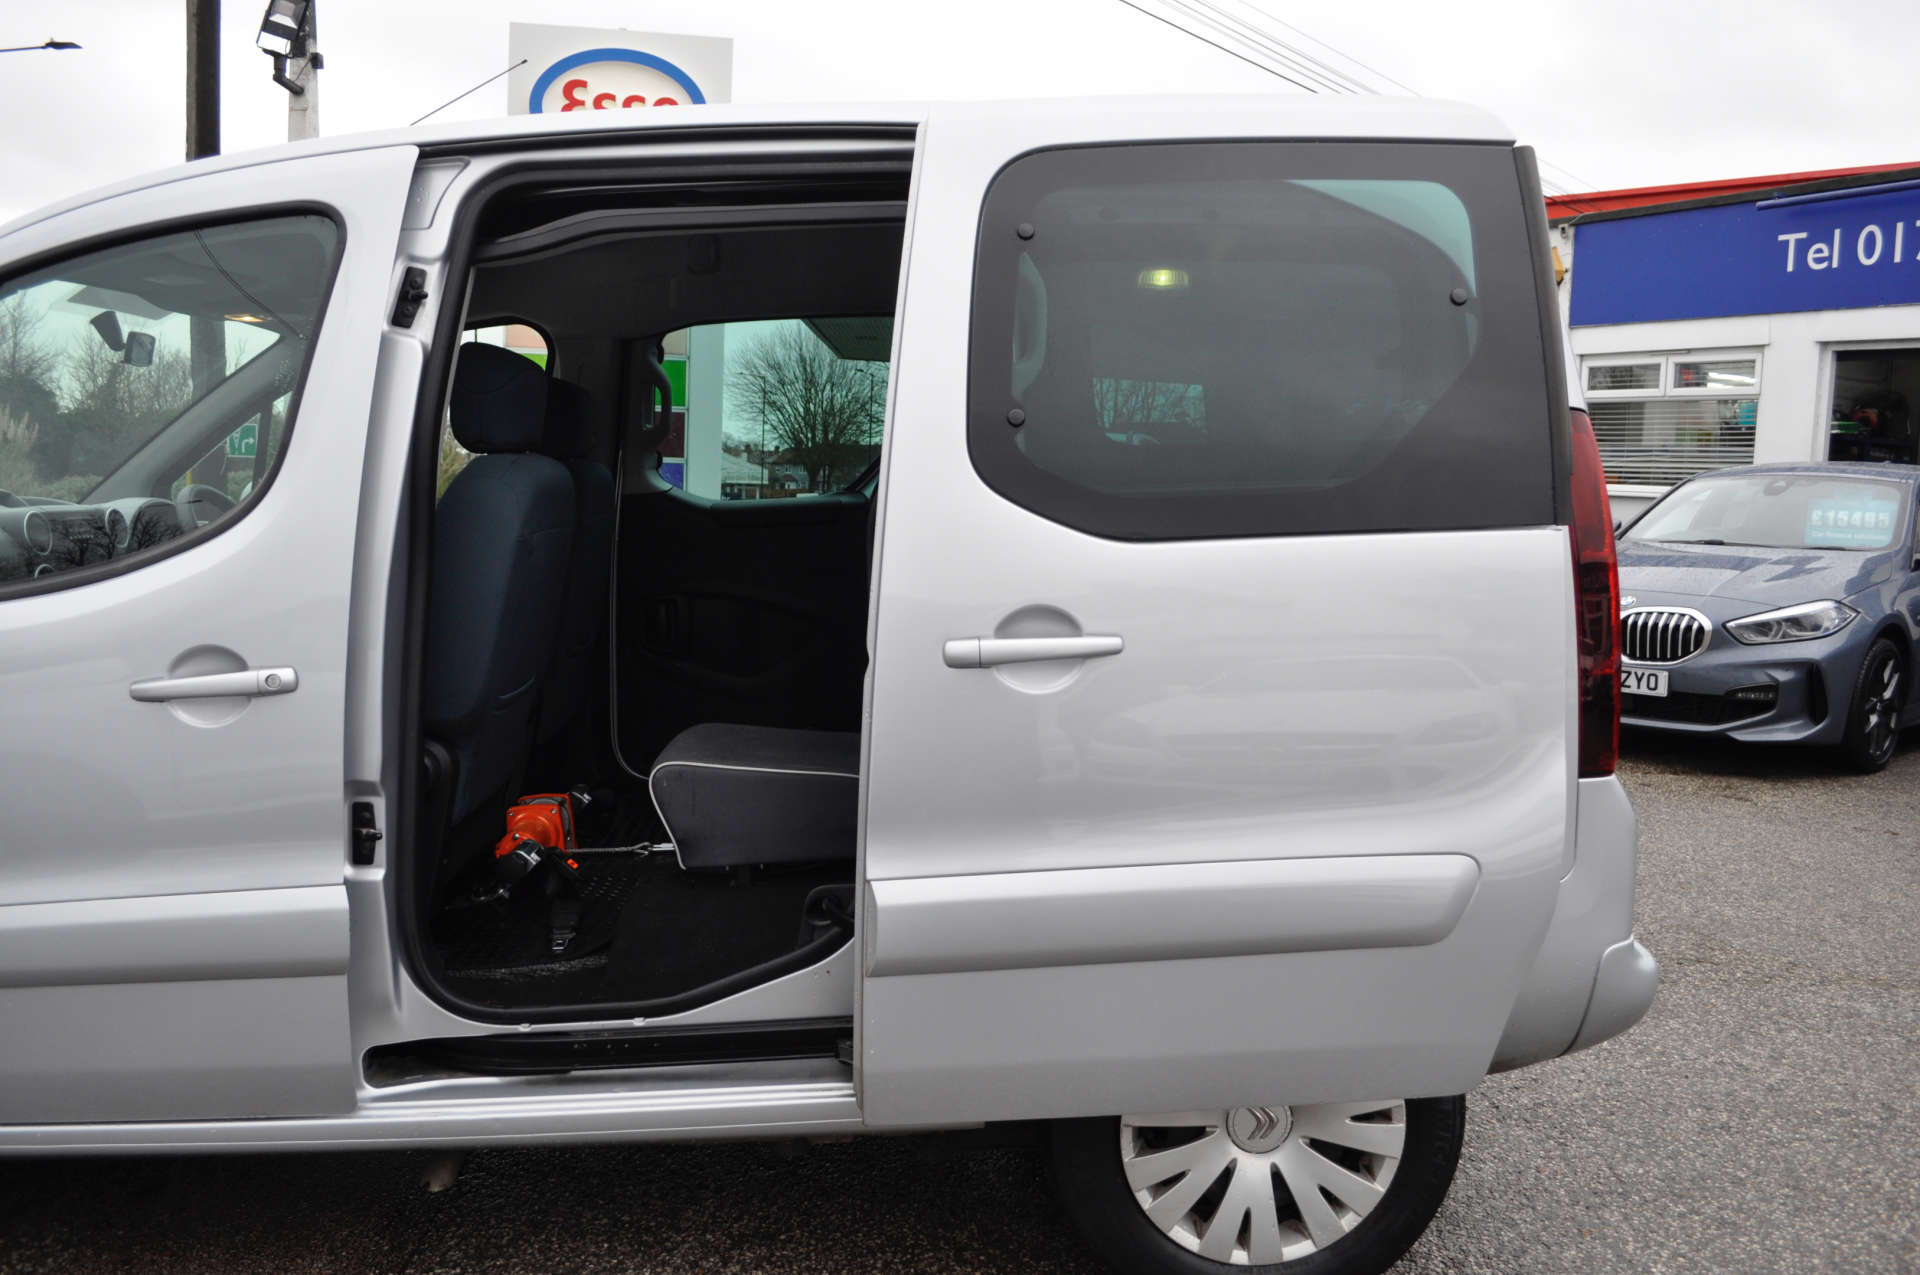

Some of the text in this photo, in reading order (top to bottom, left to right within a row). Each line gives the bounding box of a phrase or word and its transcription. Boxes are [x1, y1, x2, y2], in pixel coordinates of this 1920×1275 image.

[561, 79, 679, 112] Es
[1777, 219, 1920, 272] Tel 01
